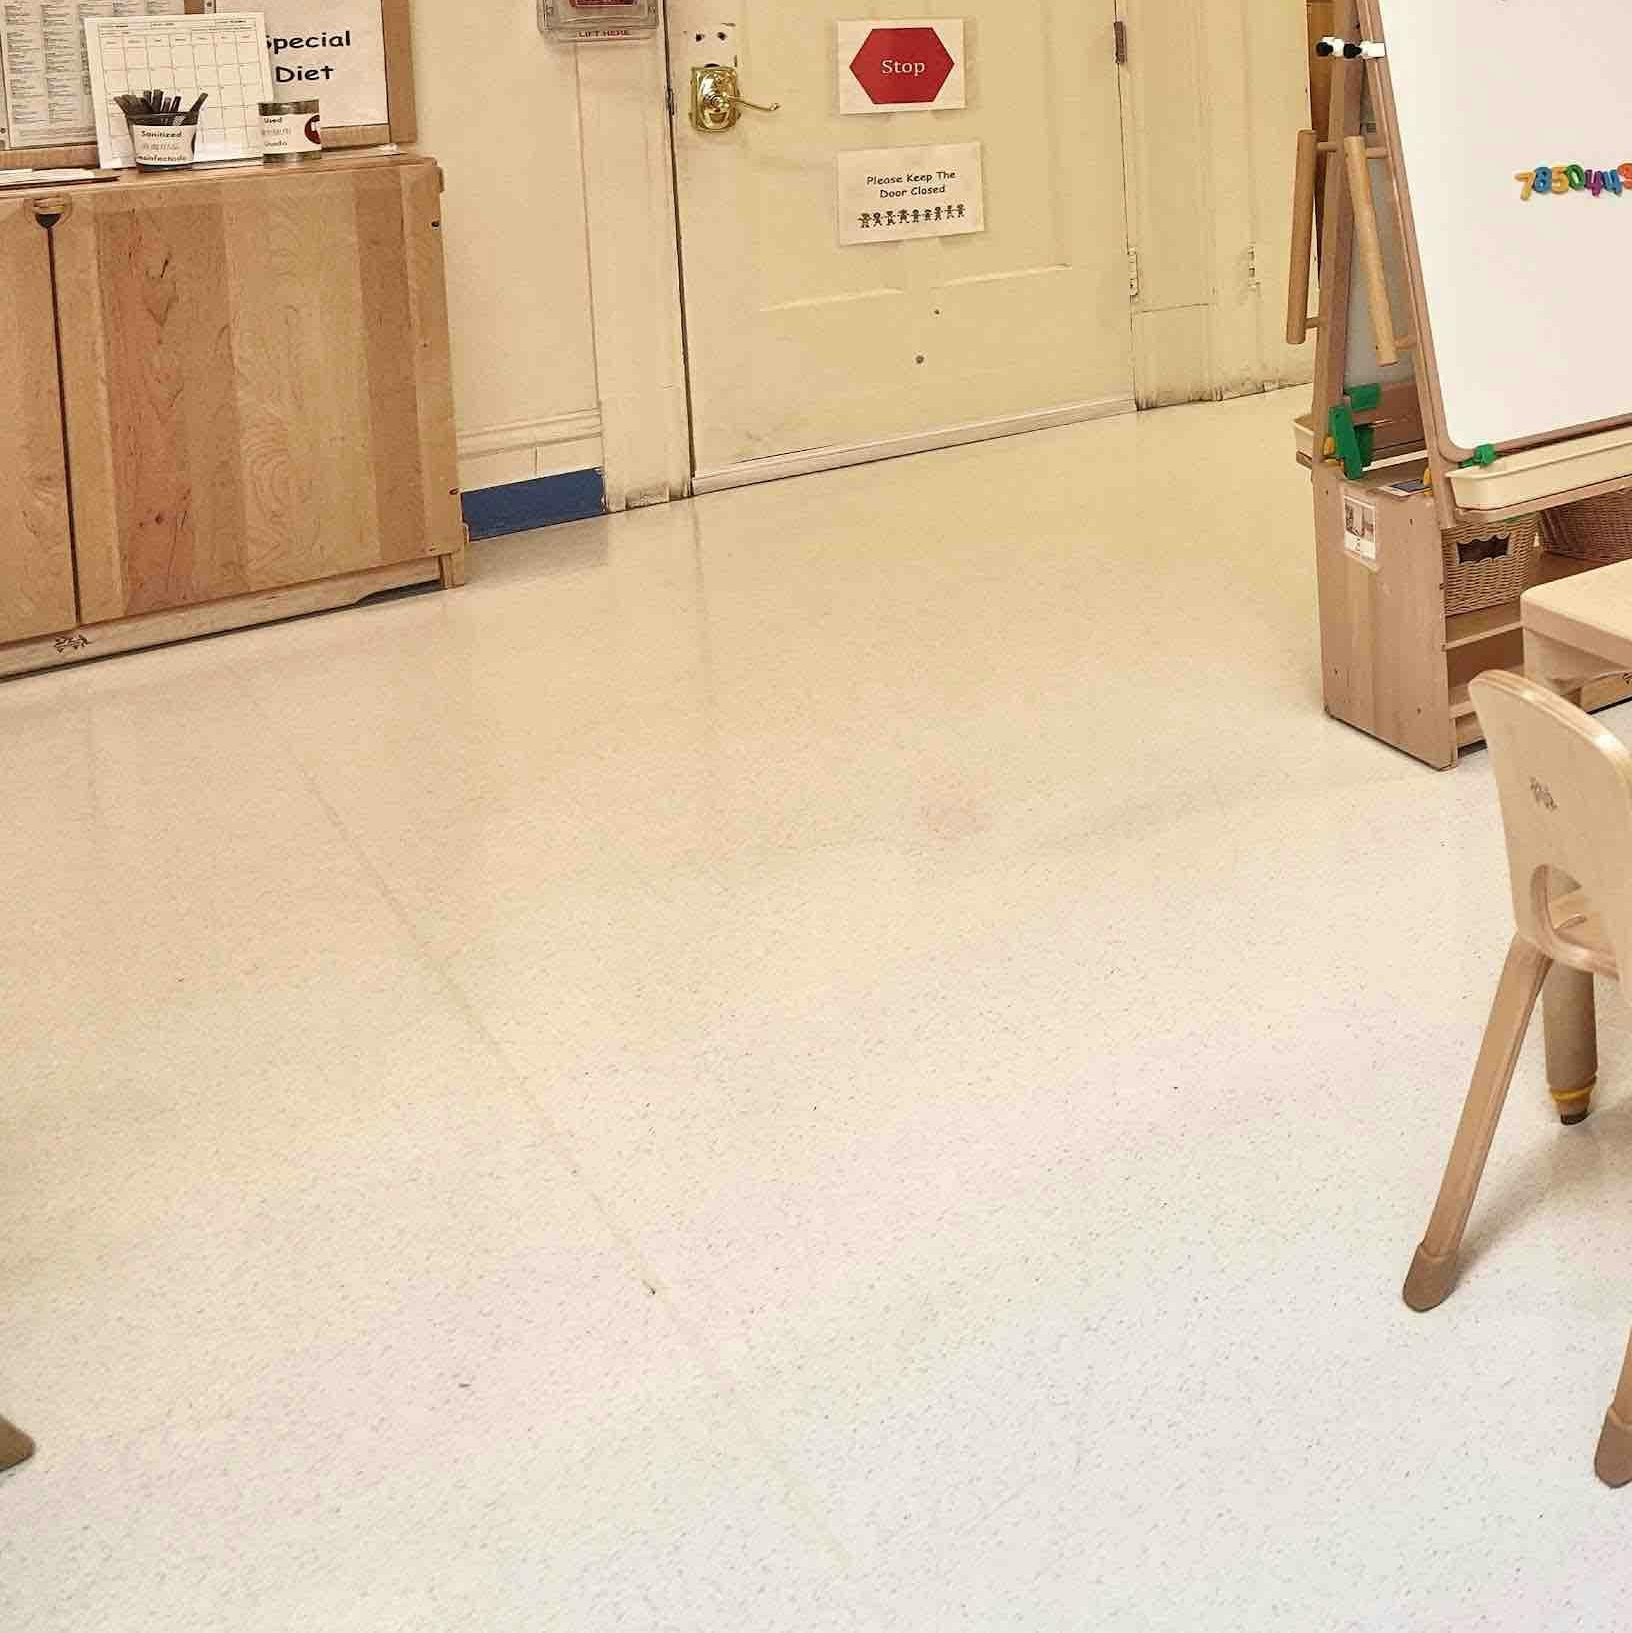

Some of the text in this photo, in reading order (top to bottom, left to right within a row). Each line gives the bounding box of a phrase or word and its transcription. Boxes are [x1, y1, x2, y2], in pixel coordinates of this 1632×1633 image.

[275, 65, 335, 83] Diet
[881, 59, 926, 76] Stop
[867, 170, 956, 186] Please Keep The
[880, 184, 946, 199] Door Closed
